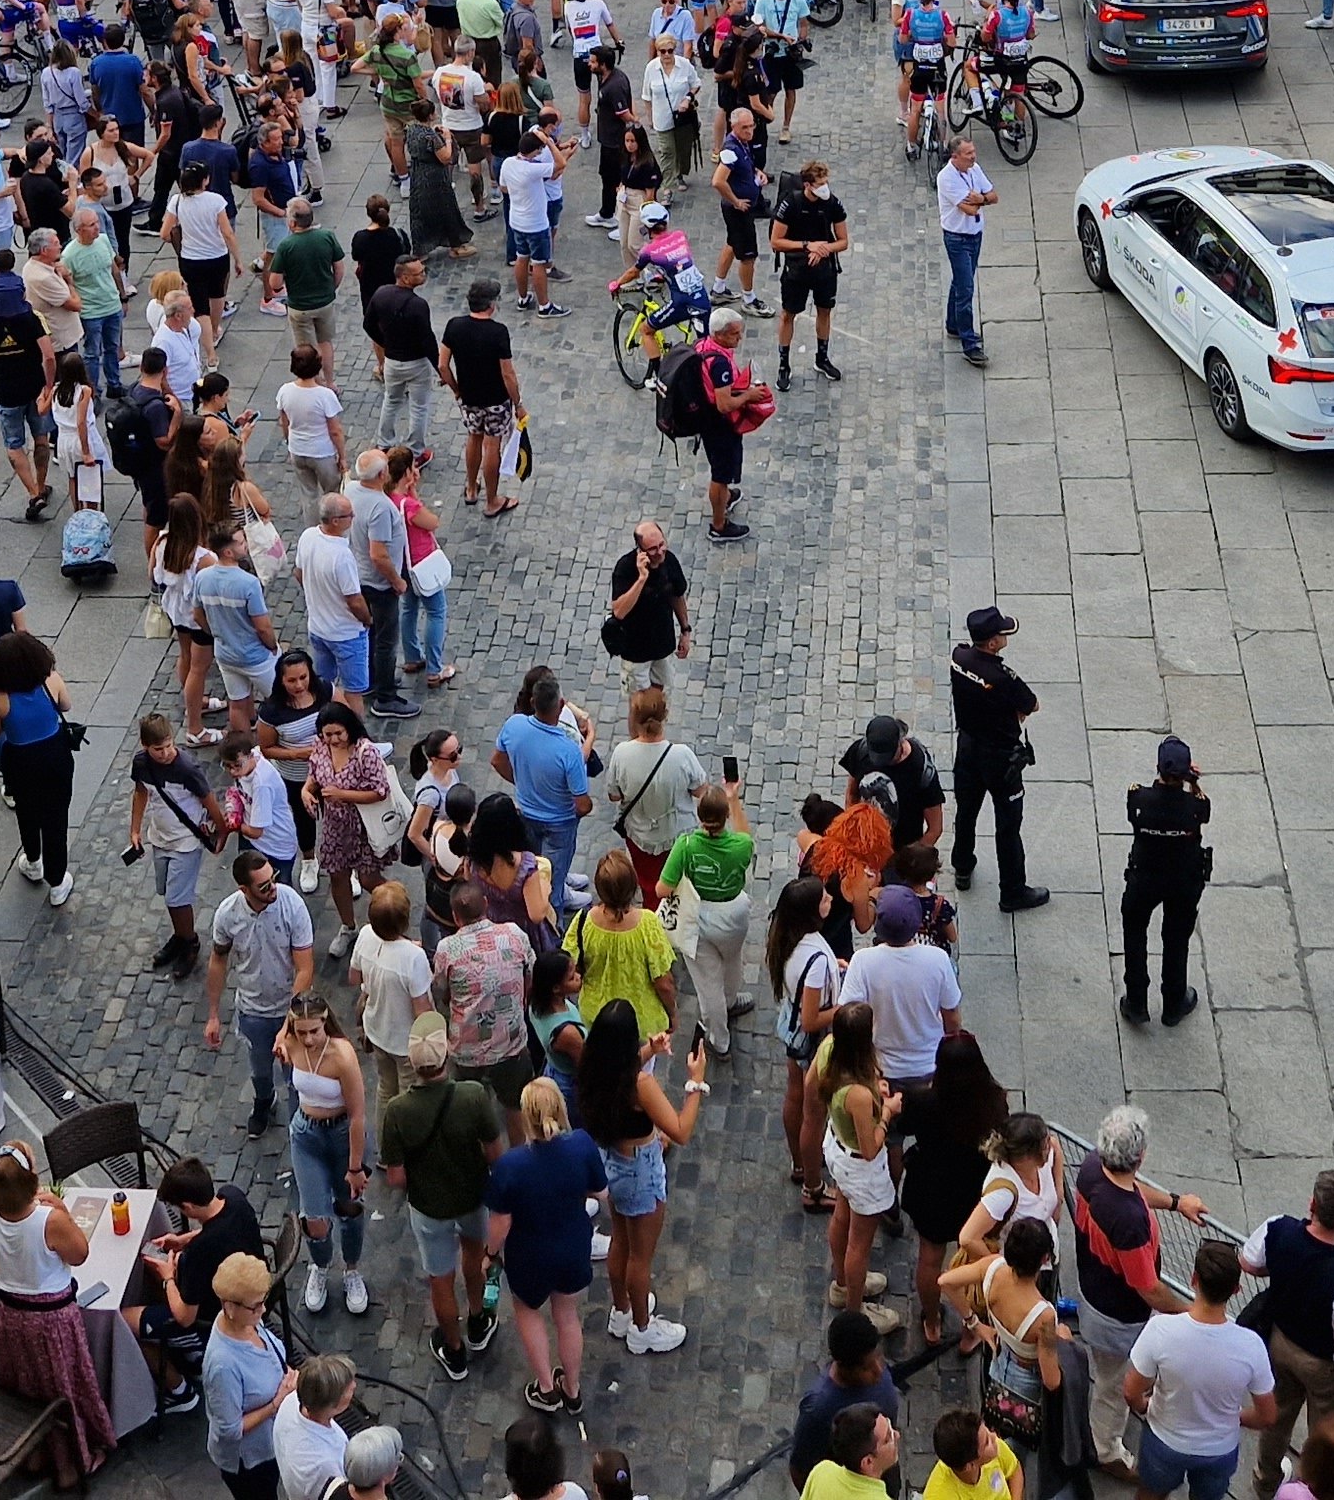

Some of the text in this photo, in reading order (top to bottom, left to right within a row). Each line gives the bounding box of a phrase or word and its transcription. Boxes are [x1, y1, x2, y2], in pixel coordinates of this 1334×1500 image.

[1166, 19, 1191, 30] 3426
[1123, 246, 1156, 288] ŠKODA
[1242, 374, 1271, 401] ŠKODA
[1140, 827, 1186, 836] POLICIA
